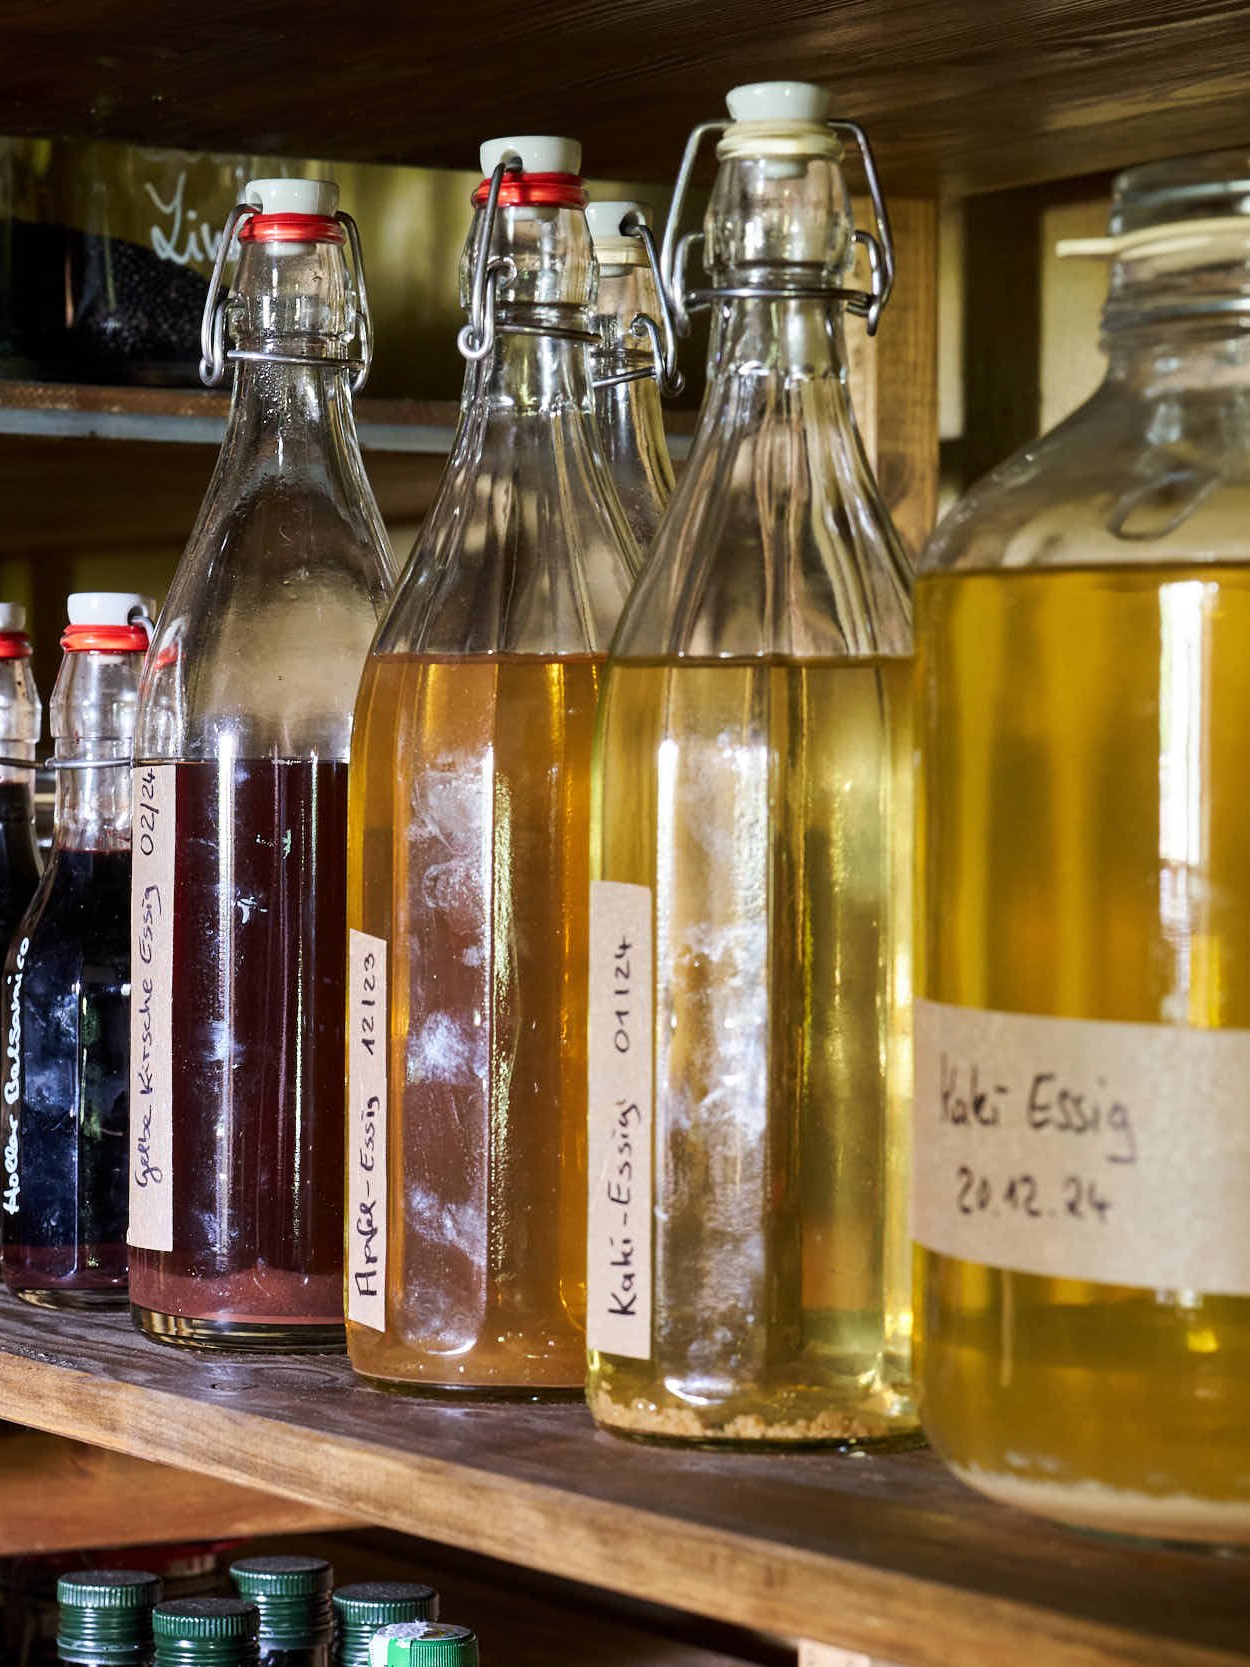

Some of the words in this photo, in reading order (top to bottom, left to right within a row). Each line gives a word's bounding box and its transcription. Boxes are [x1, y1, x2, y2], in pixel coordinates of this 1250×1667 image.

[138, 767, 159, 856] 02/24
[138, 884, 160, 963] Essig
[3, 937, 30, 1105] Balsamico
[138, 978, 154, 1094] Kirsche
[135, 1106, 162, 1188] Gelbe
[1027, 1072, 1138, 1163] Essig
[354, 1096, 380, 1296] Apfel-Essig
[607, 1102, 640, 1316] Kaki-Essig
[956, 1165, 1112, 1222] 20.12.24
